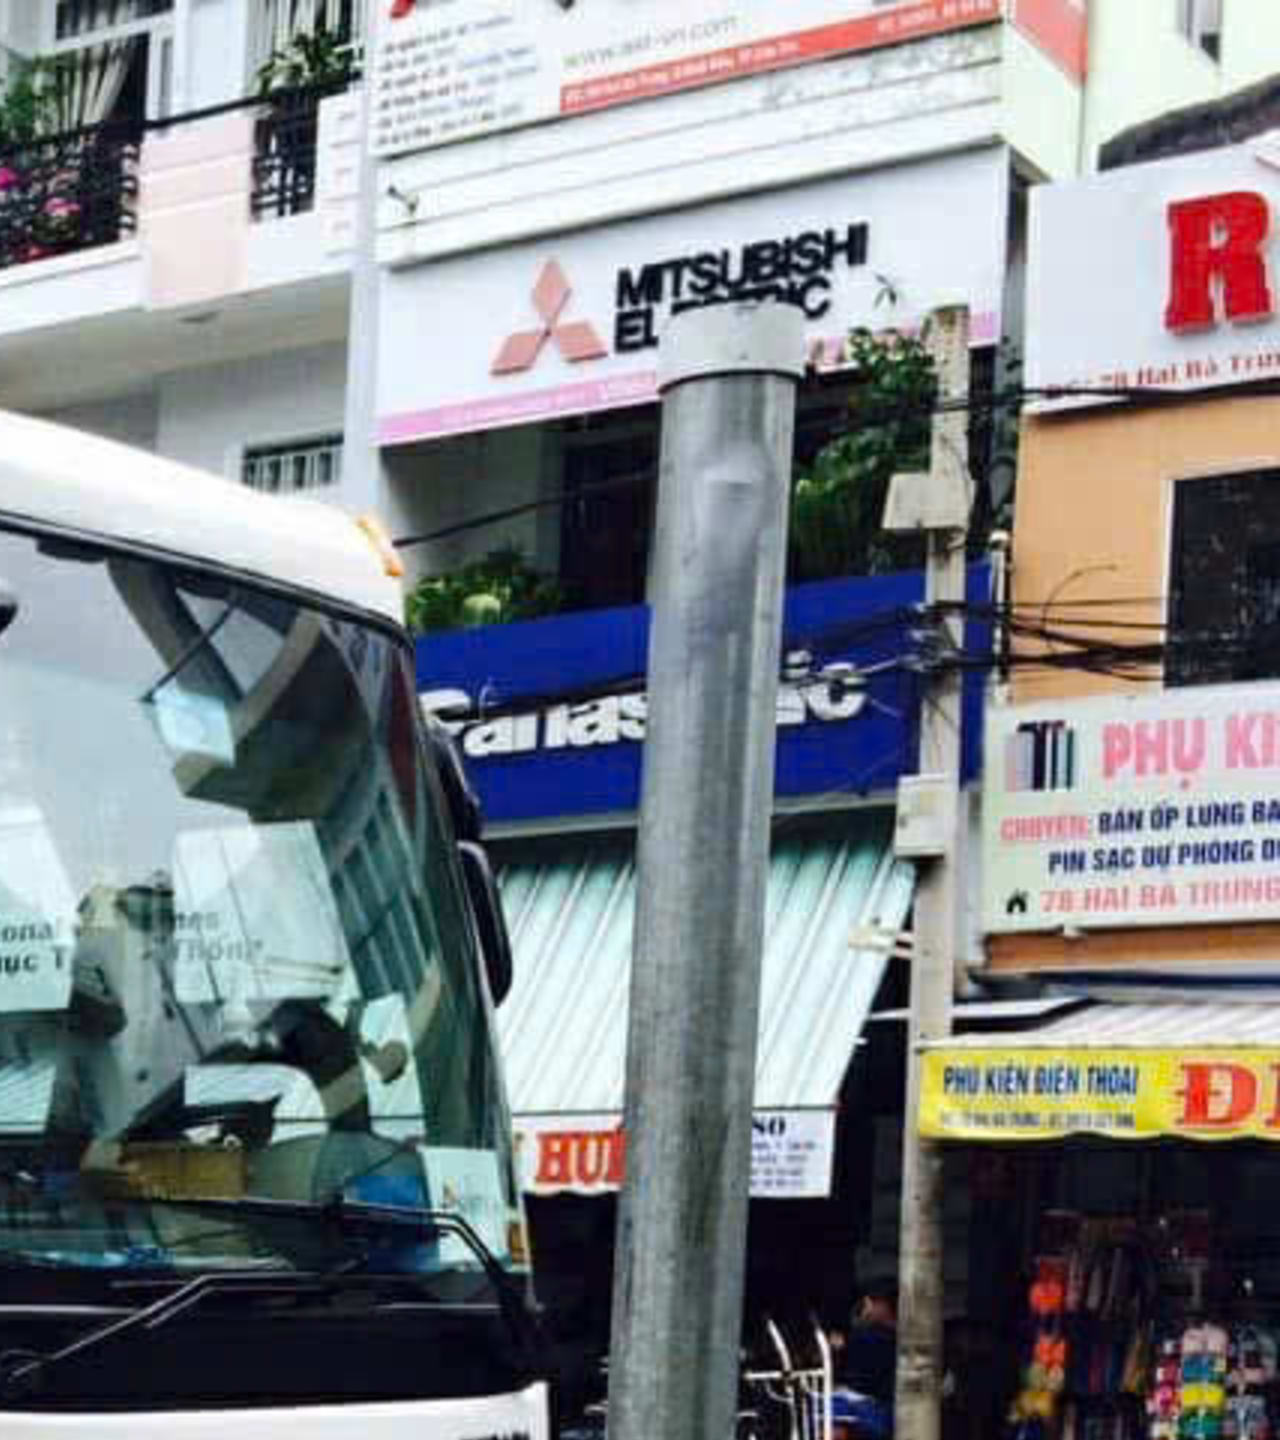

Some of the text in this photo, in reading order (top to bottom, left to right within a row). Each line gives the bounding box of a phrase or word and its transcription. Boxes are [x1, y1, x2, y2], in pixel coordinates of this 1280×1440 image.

[616, 222, 869, 308] MITSUBISHI
[1101, 718, 1207, 791] PHỤ
[1048, 850, 1085, 874] PIN
[1085, 885, 1129, 911] HAI
